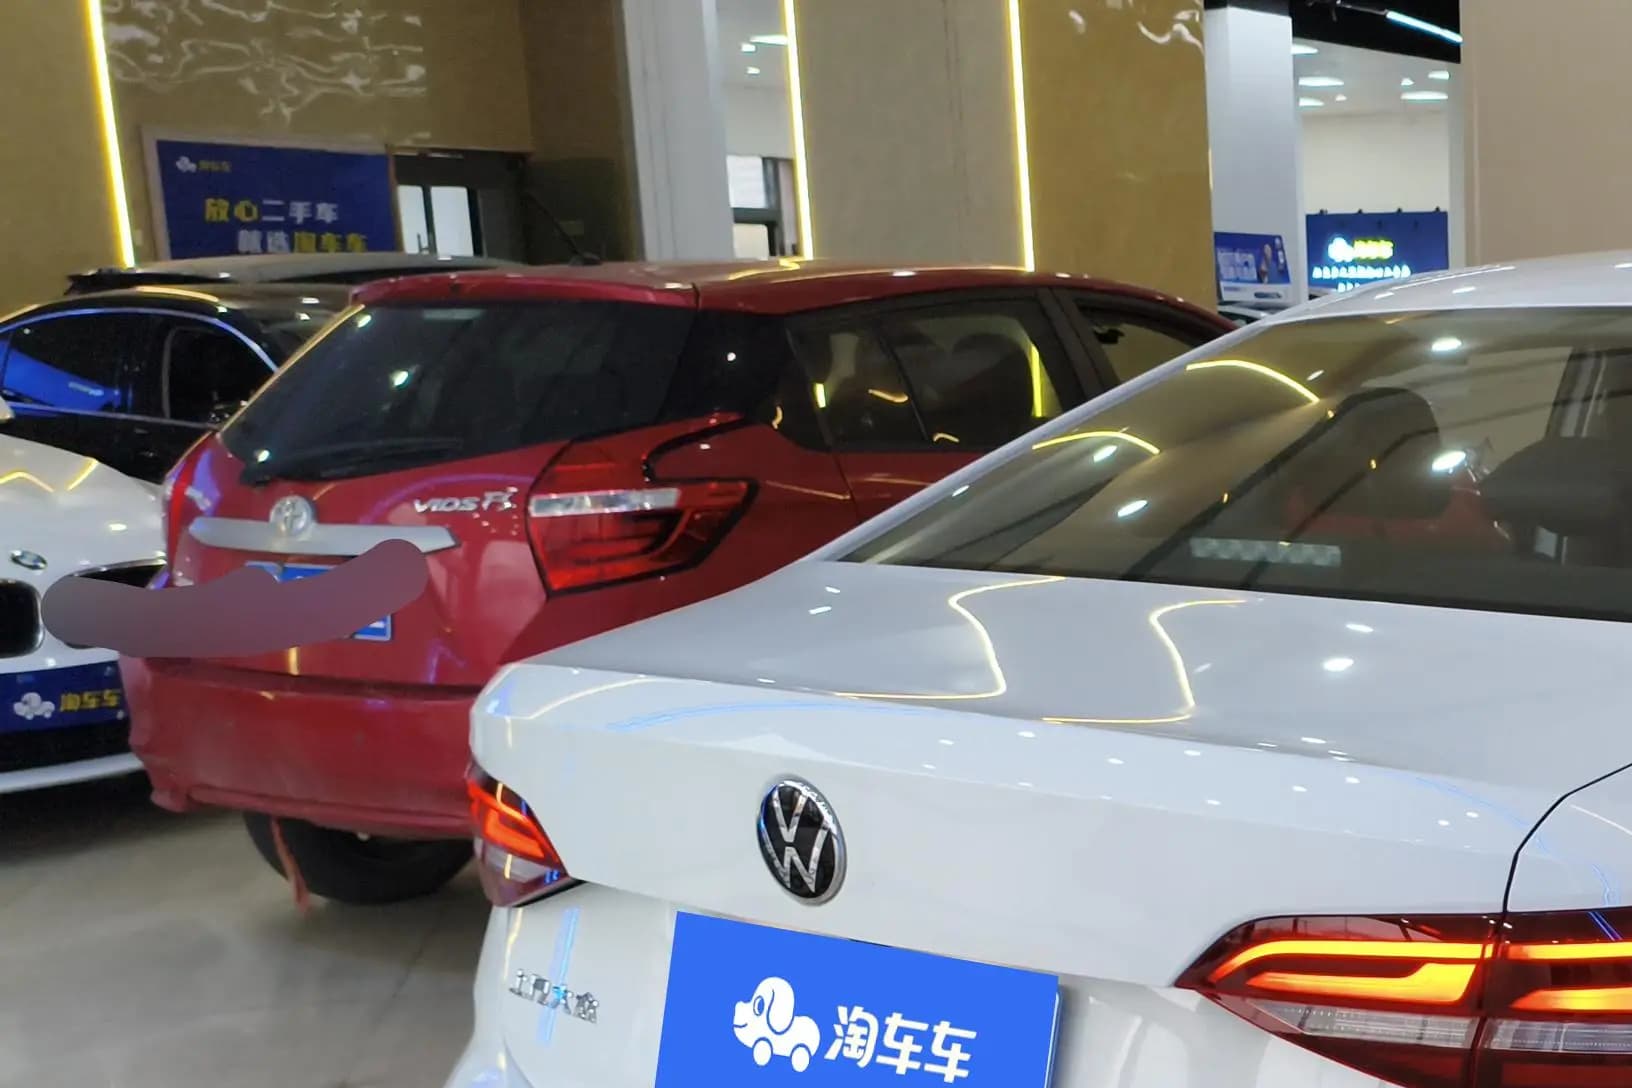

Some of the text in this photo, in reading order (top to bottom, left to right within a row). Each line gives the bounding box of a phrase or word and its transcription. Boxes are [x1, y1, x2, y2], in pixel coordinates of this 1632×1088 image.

[205, 198, 340, 225] 放心二手车
[414, 496, 481, 513] VIOS
